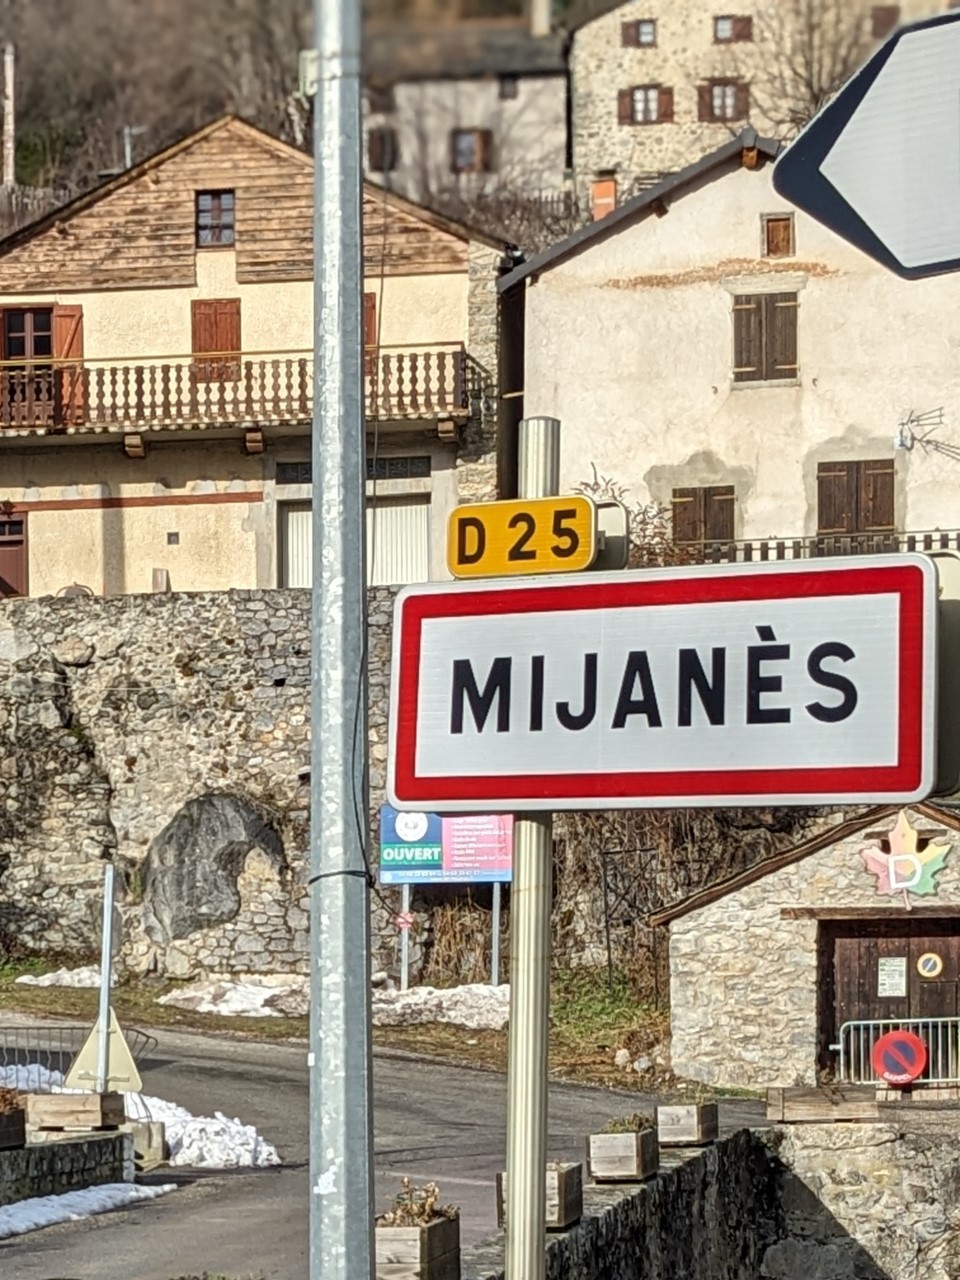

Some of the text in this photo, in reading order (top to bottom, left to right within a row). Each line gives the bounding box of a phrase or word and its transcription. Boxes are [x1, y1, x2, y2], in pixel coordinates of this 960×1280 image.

[456, 508, 581, 565] D 25
[449, 624, 859, 735] MIJANÈS
[382, 847, 442, 862] OUVERT
[888, 854, 923, 889] D
